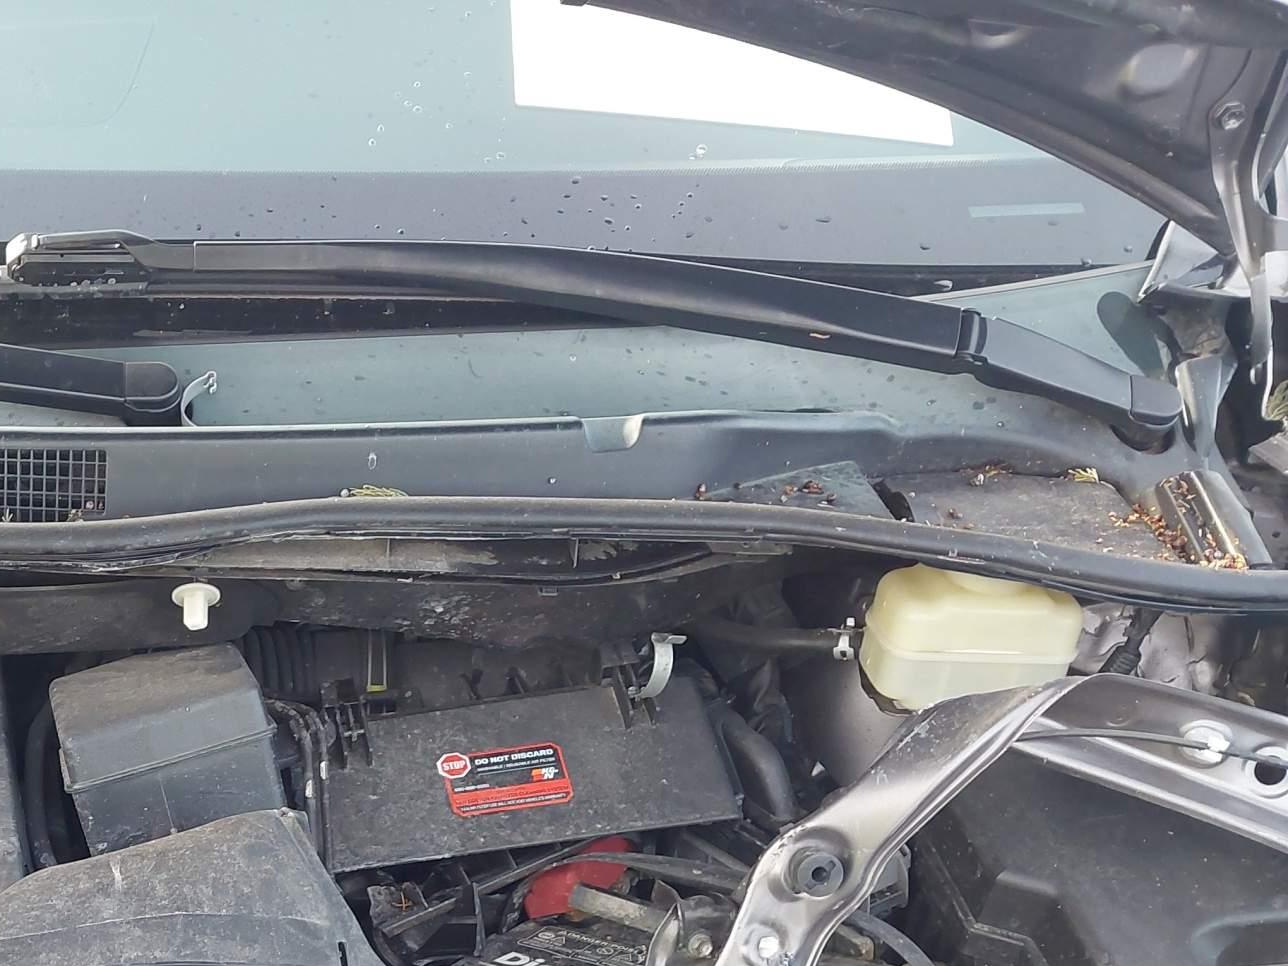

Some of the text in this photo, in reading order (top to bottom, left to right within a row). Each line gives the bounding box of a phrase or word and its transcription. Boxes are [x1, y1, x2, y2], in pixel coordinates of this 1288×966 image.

[474, 748, 554, 766] DO NOT DISCARD
[442, 760, 466, 771] STOP
